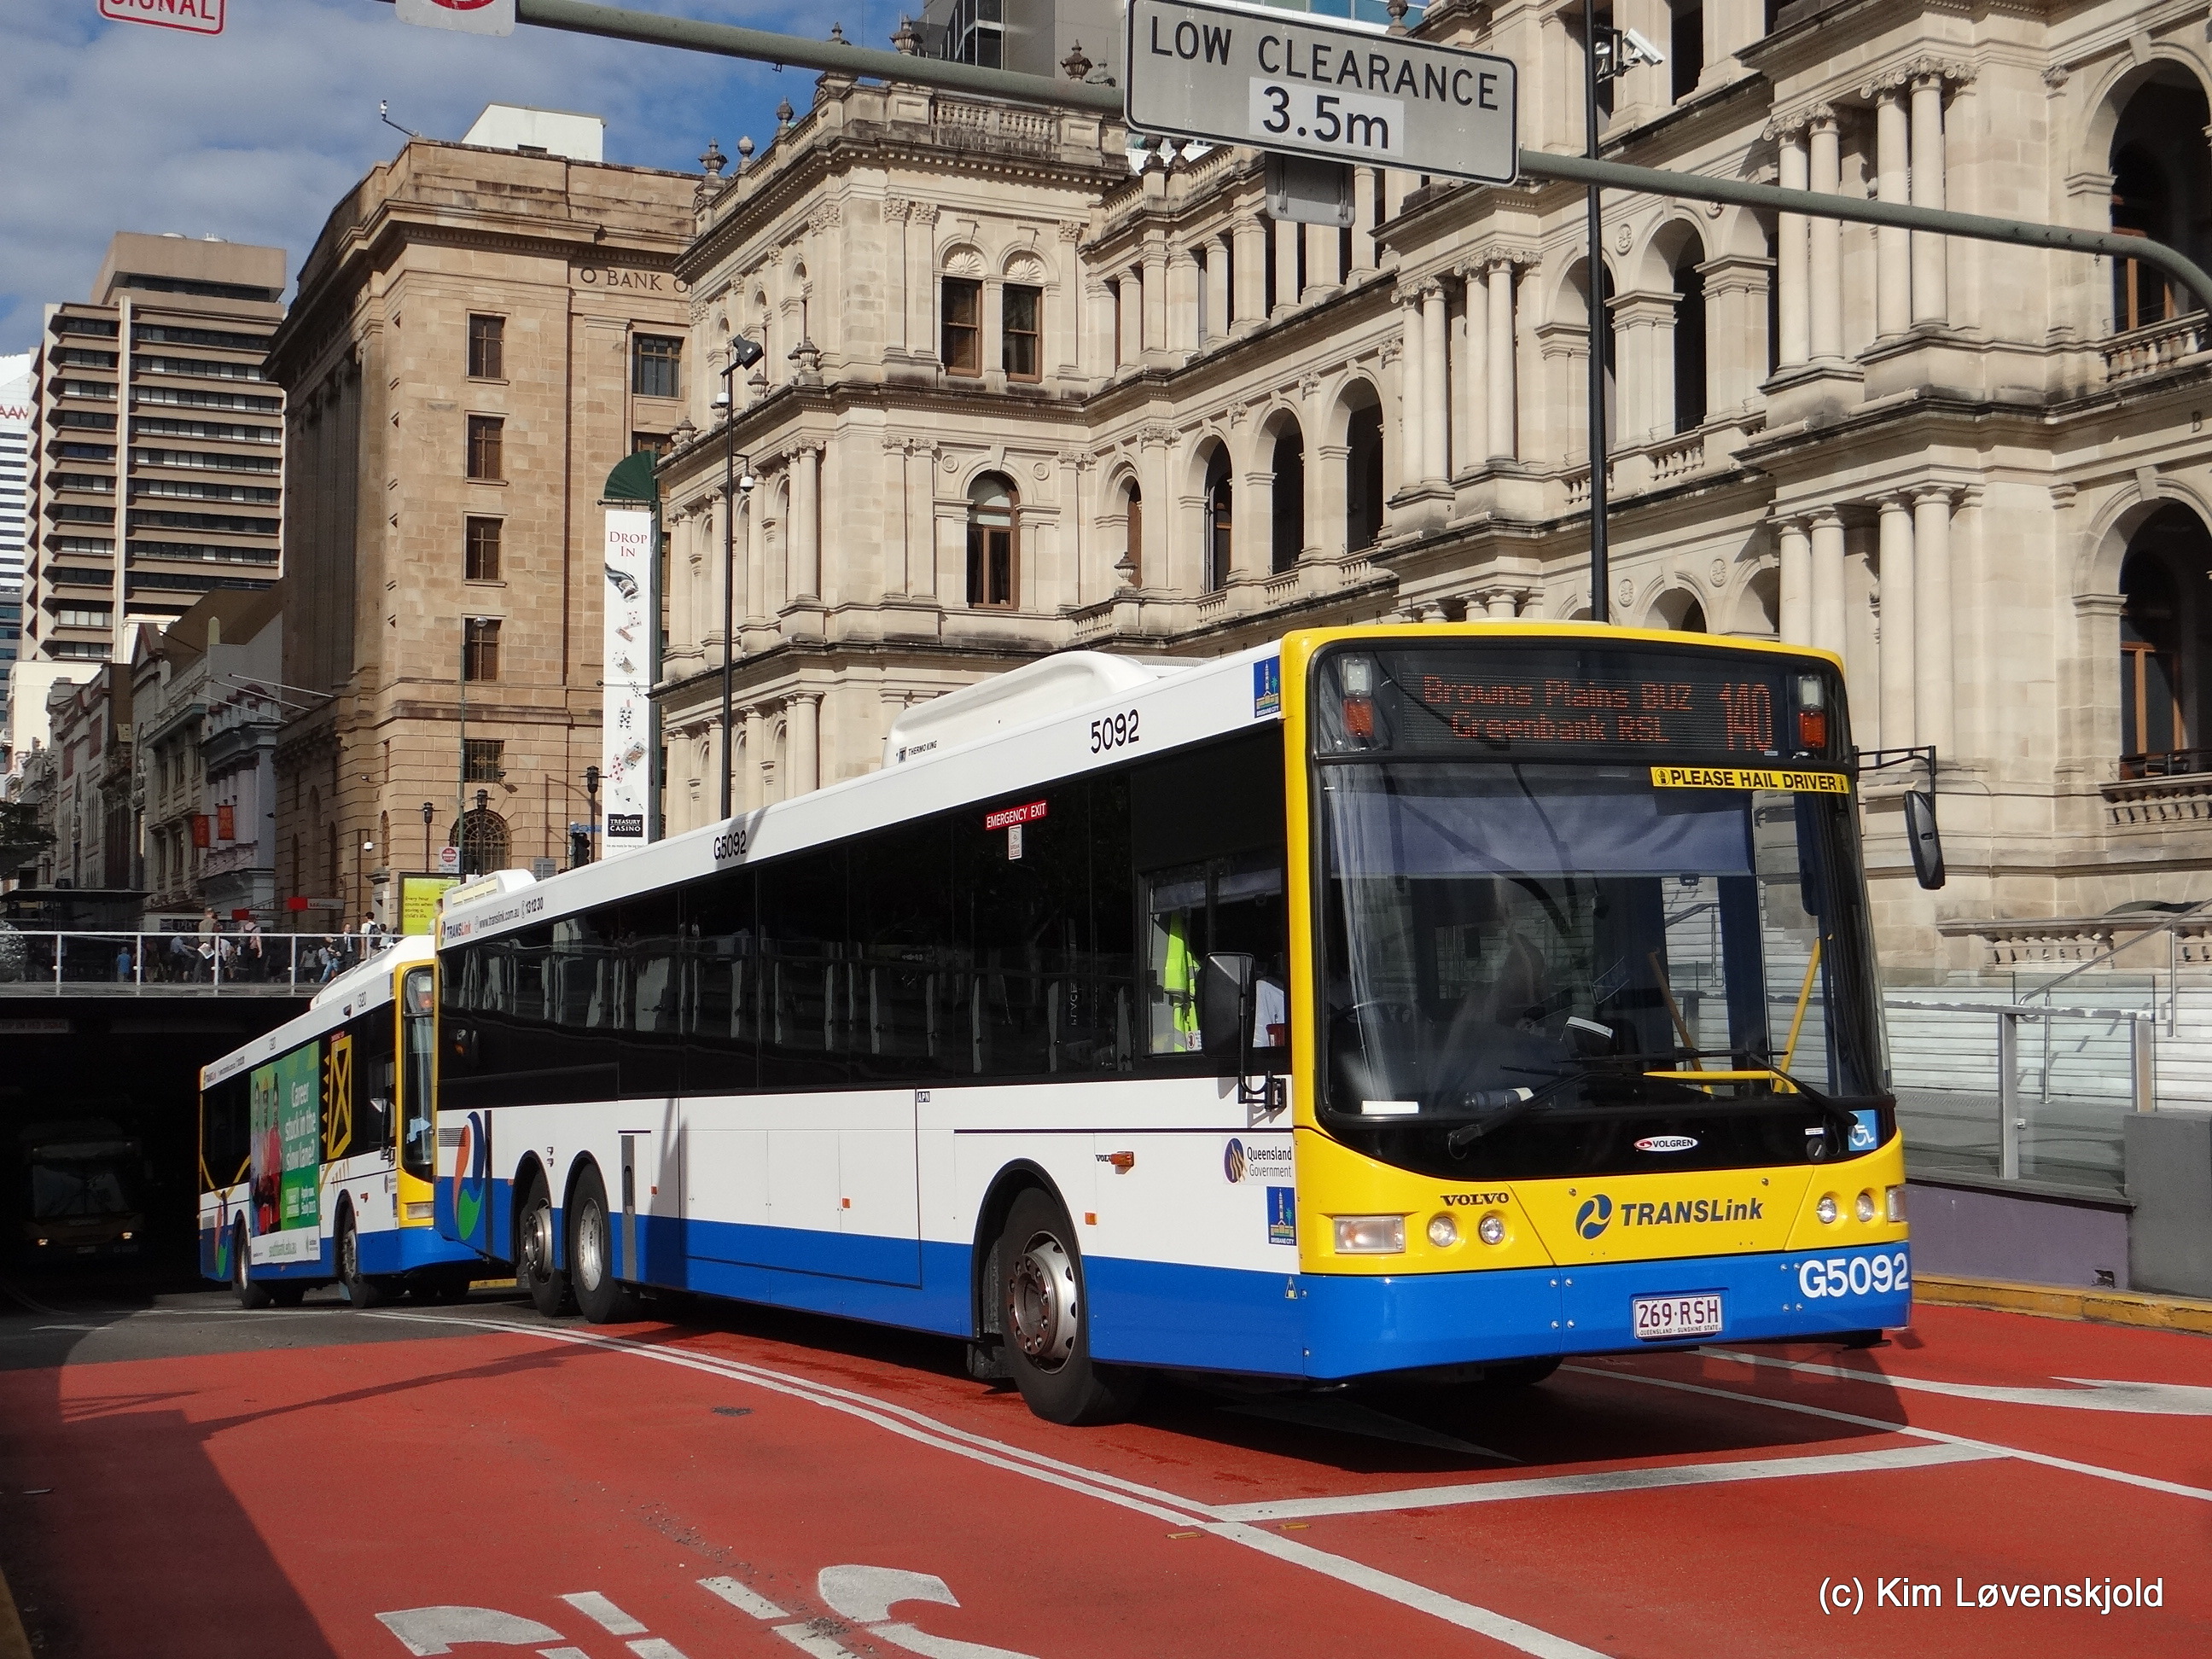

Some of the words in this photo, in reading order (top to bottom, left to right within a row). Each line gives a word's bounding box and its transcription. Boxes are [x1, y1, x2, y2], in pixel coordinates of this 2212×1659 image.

[1151, 15, 1232, 66] LOW
[1258, 35, 1499, 112] CLEARANCE
[1263, 85, 1388, 150] 3.5m
[607, 270, 662, 291] BANK
[609, 531, 648, 544] DROP
[620, 545, 636, 557] IN
[1423, 674, 1533, 707] Browns
[1545, 679, 1629, 710] Plains
[1640, 683, 1693, 711] BUZ
[1091, 708, 1139, 754] 5092
[1451, 711, 1606, 742] Greenbank
[1618, 715, 1670, 742] RSL
[1718, 682, 1773, 752] 140
[908, 743, 927, 756] THERMO
[927, 740, 937, 751] KING
[1671, 769, 1735, 787] PLEASE
[1739, 771, 1778, 788] HAIL
[1783, 773, 1837, 790] DRIVER
[987, 807, 1027, 828] EMERGENCY
[1030, 802, 1046, 818] EXIT
[713, 830, 747, 860] G5092
[446, 920, 471, 940] TRANSLink
[479, 908, 520, 929] www.translink.com.au
[291, 1080, 310, 1109] Career
[917, 1091, 930, 1103] APN
[285, 1110, 300, 1142] stuck
[300, 1109, 306, 1138] in
[306, 1106, 317, 1135] the
[287, 1144, 300, 1172] slow
[299, 1138, 315, 1169] lane?
[1247, 1146, 1292, 1161] Queensland
[1652, 1138, 1694, 1149] VOLGREN
[1249, 1163, 1292, 1178] Government
[1440, 1192, 1510, 1207] VOLVO
[1621, 1197, 1764, 1226] TRANSLink
[1799, 1252, 1909, 1299] G5092
